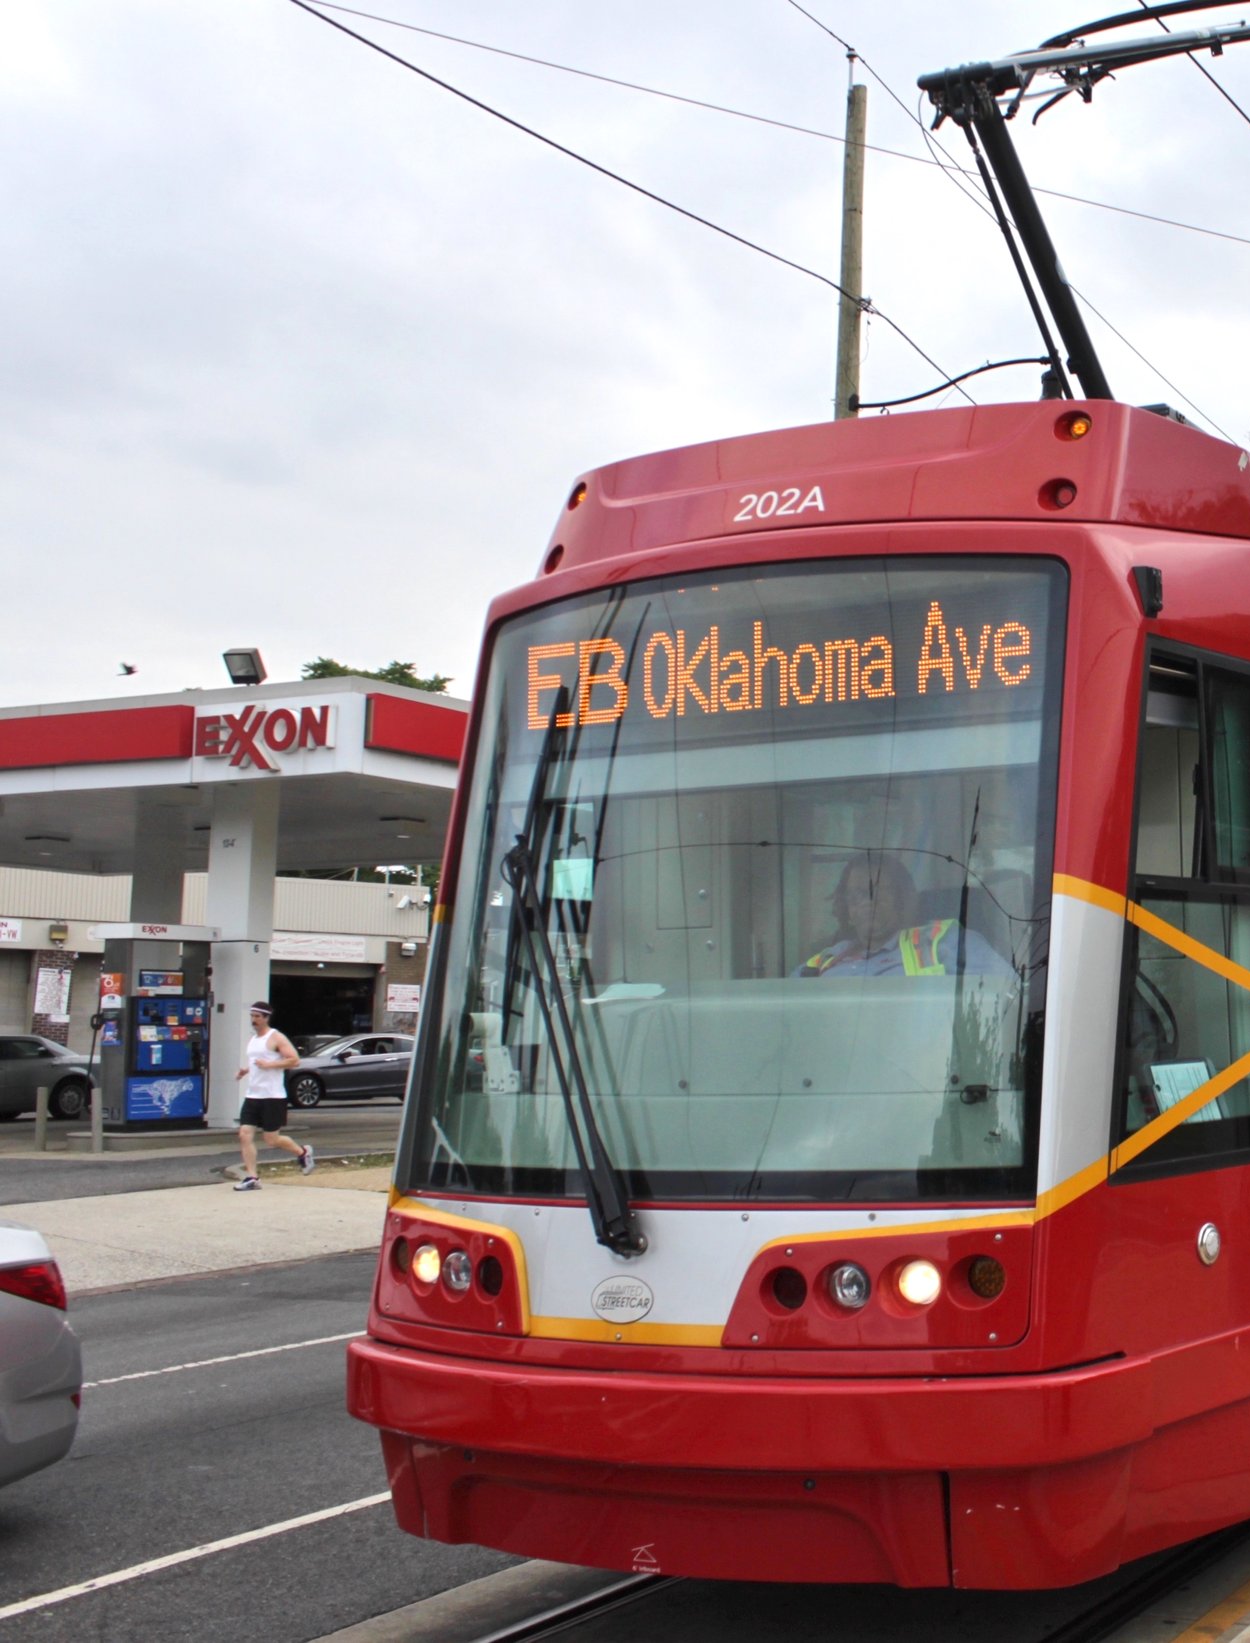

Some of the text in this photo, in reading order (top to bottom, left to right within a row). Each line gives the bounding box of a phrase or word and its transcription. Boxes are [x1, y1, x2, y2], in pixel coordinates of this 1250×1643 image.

[733, 485, 825, 522] 202A
[527, 636, 629, 730] EB
[917, 601, 1031, 693] Ave
[194, 703, 334, 772] EXXON
[142, 925, 167, 936] EXXON
[253, 944, 259, 953] 6
[601, 1296, 651, 1309] STREETCAR
